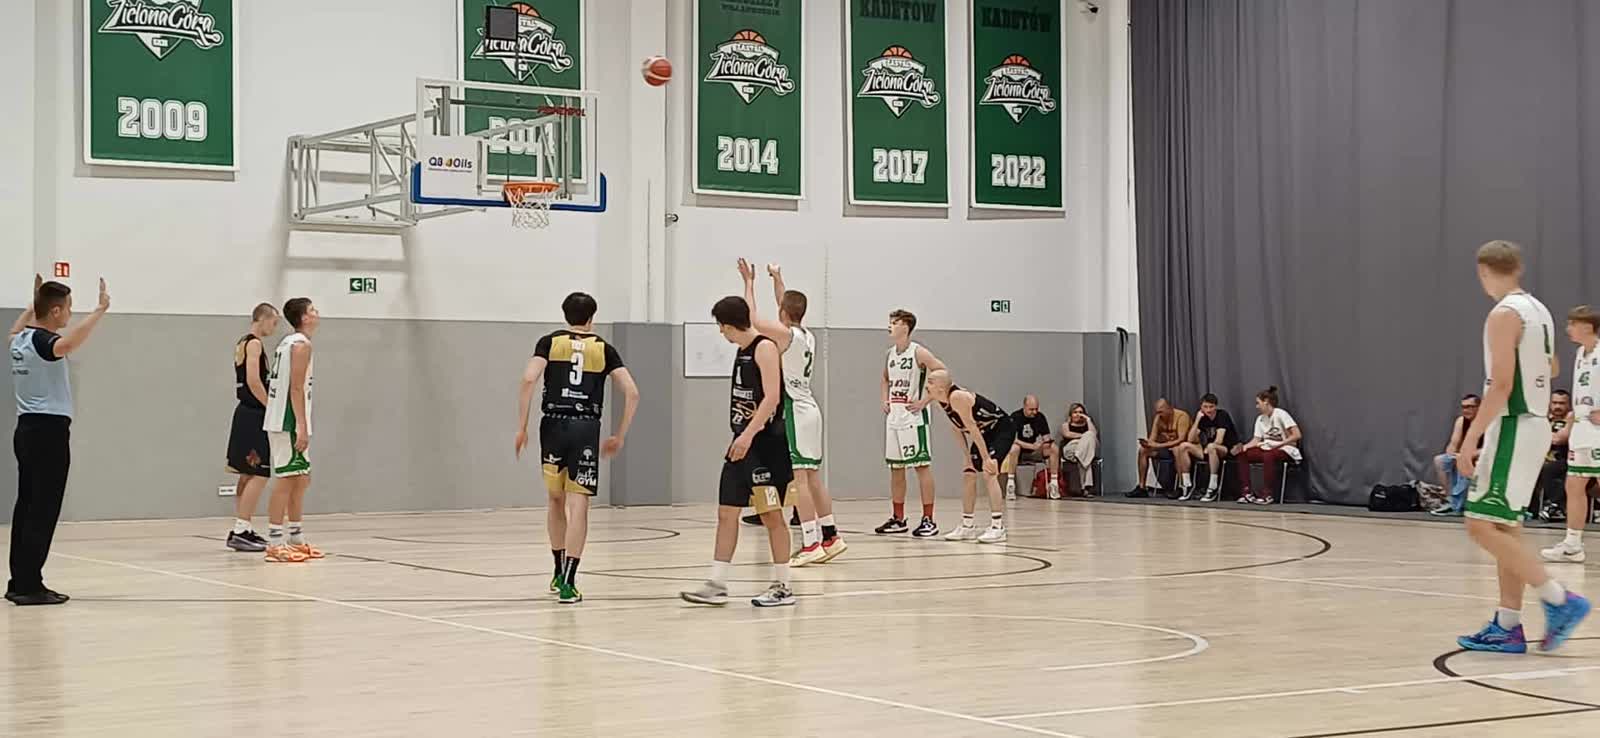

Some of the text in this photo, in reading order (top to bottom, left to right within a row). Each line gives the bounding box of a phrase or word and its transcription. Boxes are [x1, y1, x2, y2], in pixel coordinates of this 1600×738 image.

[117, 96, 208, 141] 2009
[717, 136, 779, 174] 2014
[872, 148, 929, 184] 2017
[991, 154, 1046, 188] 2022
[569, 351, 584, 386] 3
[803, 350, 813, 378] 2
[900, 357, 913, 369] 23
[903, 444, 916, 458] 23
[577, 476, 596, 487] GYM
